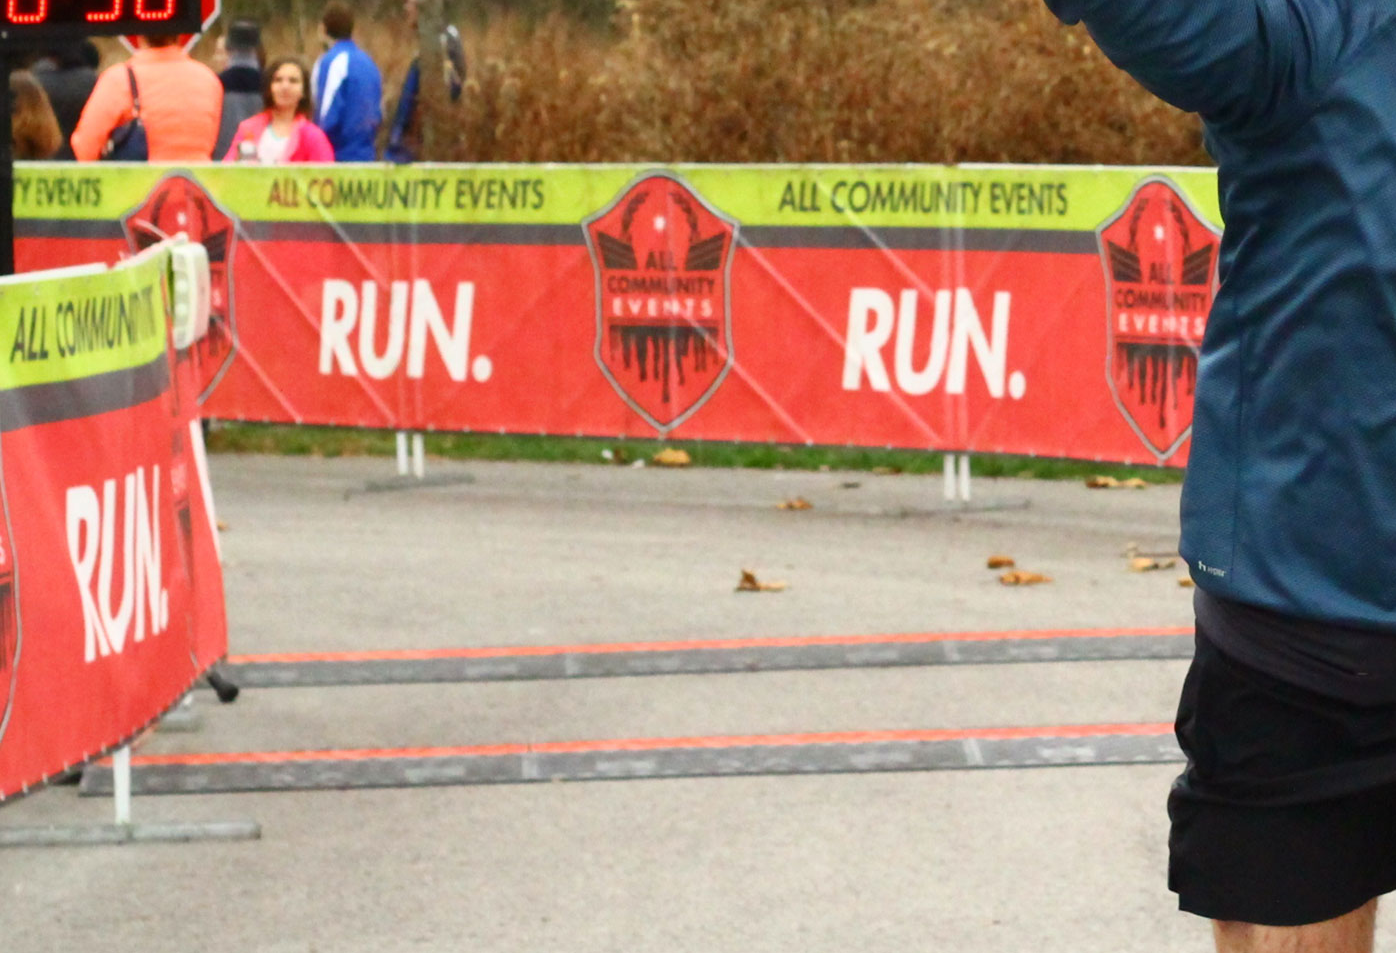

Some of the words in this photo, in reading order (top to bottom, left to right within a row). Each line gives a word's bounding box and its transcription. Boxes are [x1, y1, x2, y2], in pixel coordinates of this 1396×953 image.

[36, 177, 102, 206] EVENTS
[267, 178, 299, 207] ALL
[307, 178, 447, 209] COMMUNITY
[455, 179, 544, 211] EVENTS
[779, 180, 820, 213] ALL
[832, 180, 982, 215] COMMUNITY
[990, 182, 1068, 216] EVENTS
[608, 276, 715, 296] COMMUNITY
[612, 297, 714, 317] EVENTS
[10, 306, 50, 363] ALL
[319, 278, 493, 382] RUN.
[1118, 313, 1205, 336] EVENTS
[842, 287, 1026, 400] RUN.
[66, 465, 168, 663] RUN.
